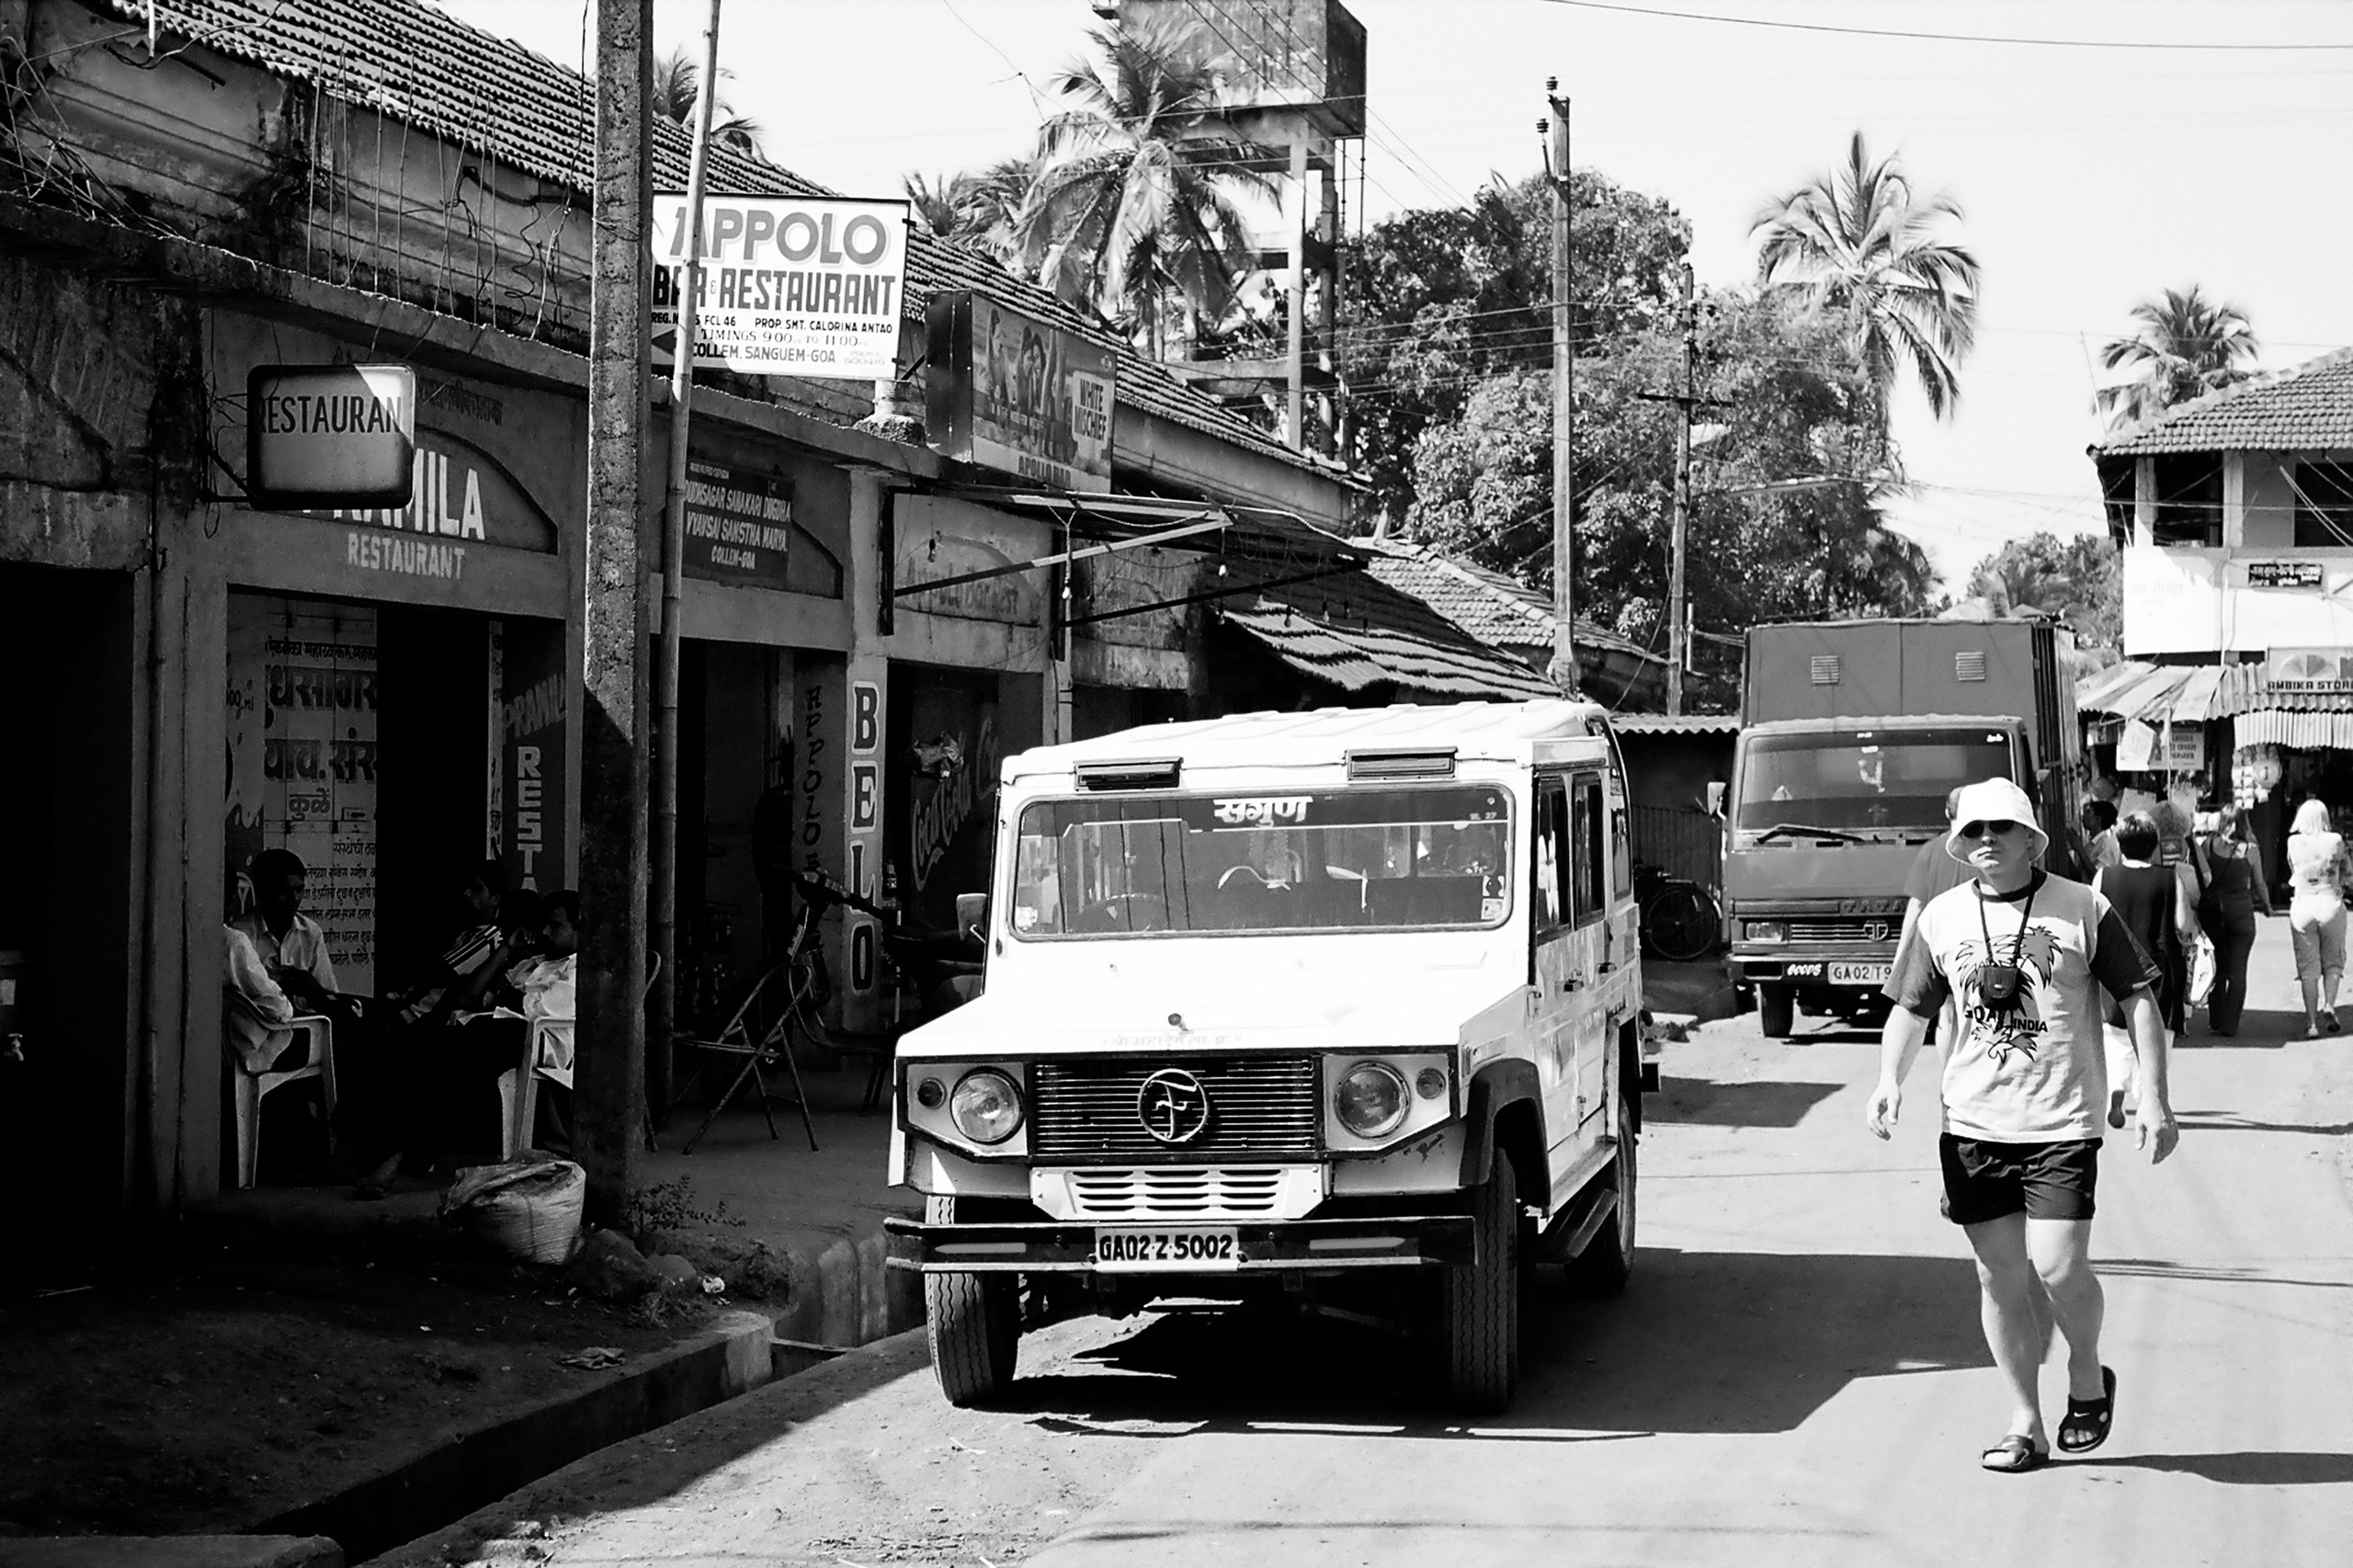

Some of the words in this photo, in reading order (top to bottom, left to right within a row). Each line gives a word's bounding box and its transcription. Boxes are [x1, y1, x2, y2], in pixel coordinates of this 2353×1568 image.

[719, 267, 896, 315] RESTAURANT
[704, 315, 721, 325] FCL
[723, 315, 736, 326] 46
[755, 318, 783, 329] PROP.
[786, 320, 807, 330] SMT.
[809, 320, 858, 332] CALORINA
[861, 323, 892, 334] ANTAO
[700, 328, 756, 342] TIMINGS
[347, 532, 465, 579] RESTAURANT
[226, 688, 242, 707] 00
[503, 671, 567, 741] PRAMIL
[2014, 1017, 2048, 1032] INDIA
